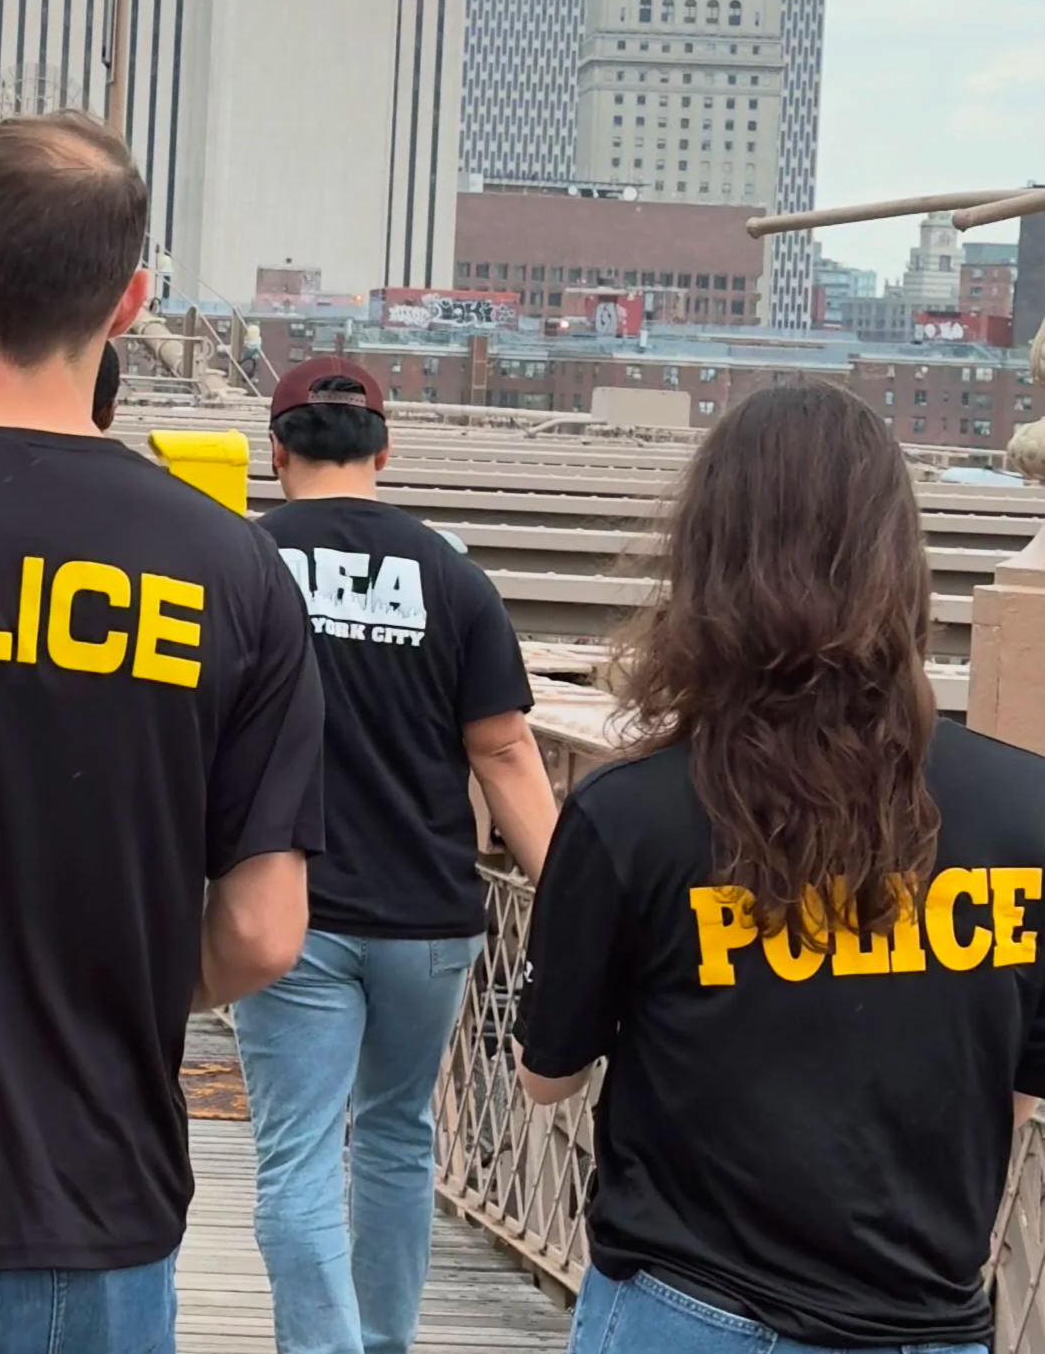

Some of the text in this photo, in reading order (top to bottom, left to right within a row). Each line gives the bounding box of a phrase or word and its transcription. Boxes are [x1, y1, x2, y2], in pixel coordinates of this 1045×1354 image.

[311, 617, 425, 647] YORK CITY
[689, 867, 1043, 986] POLICE
